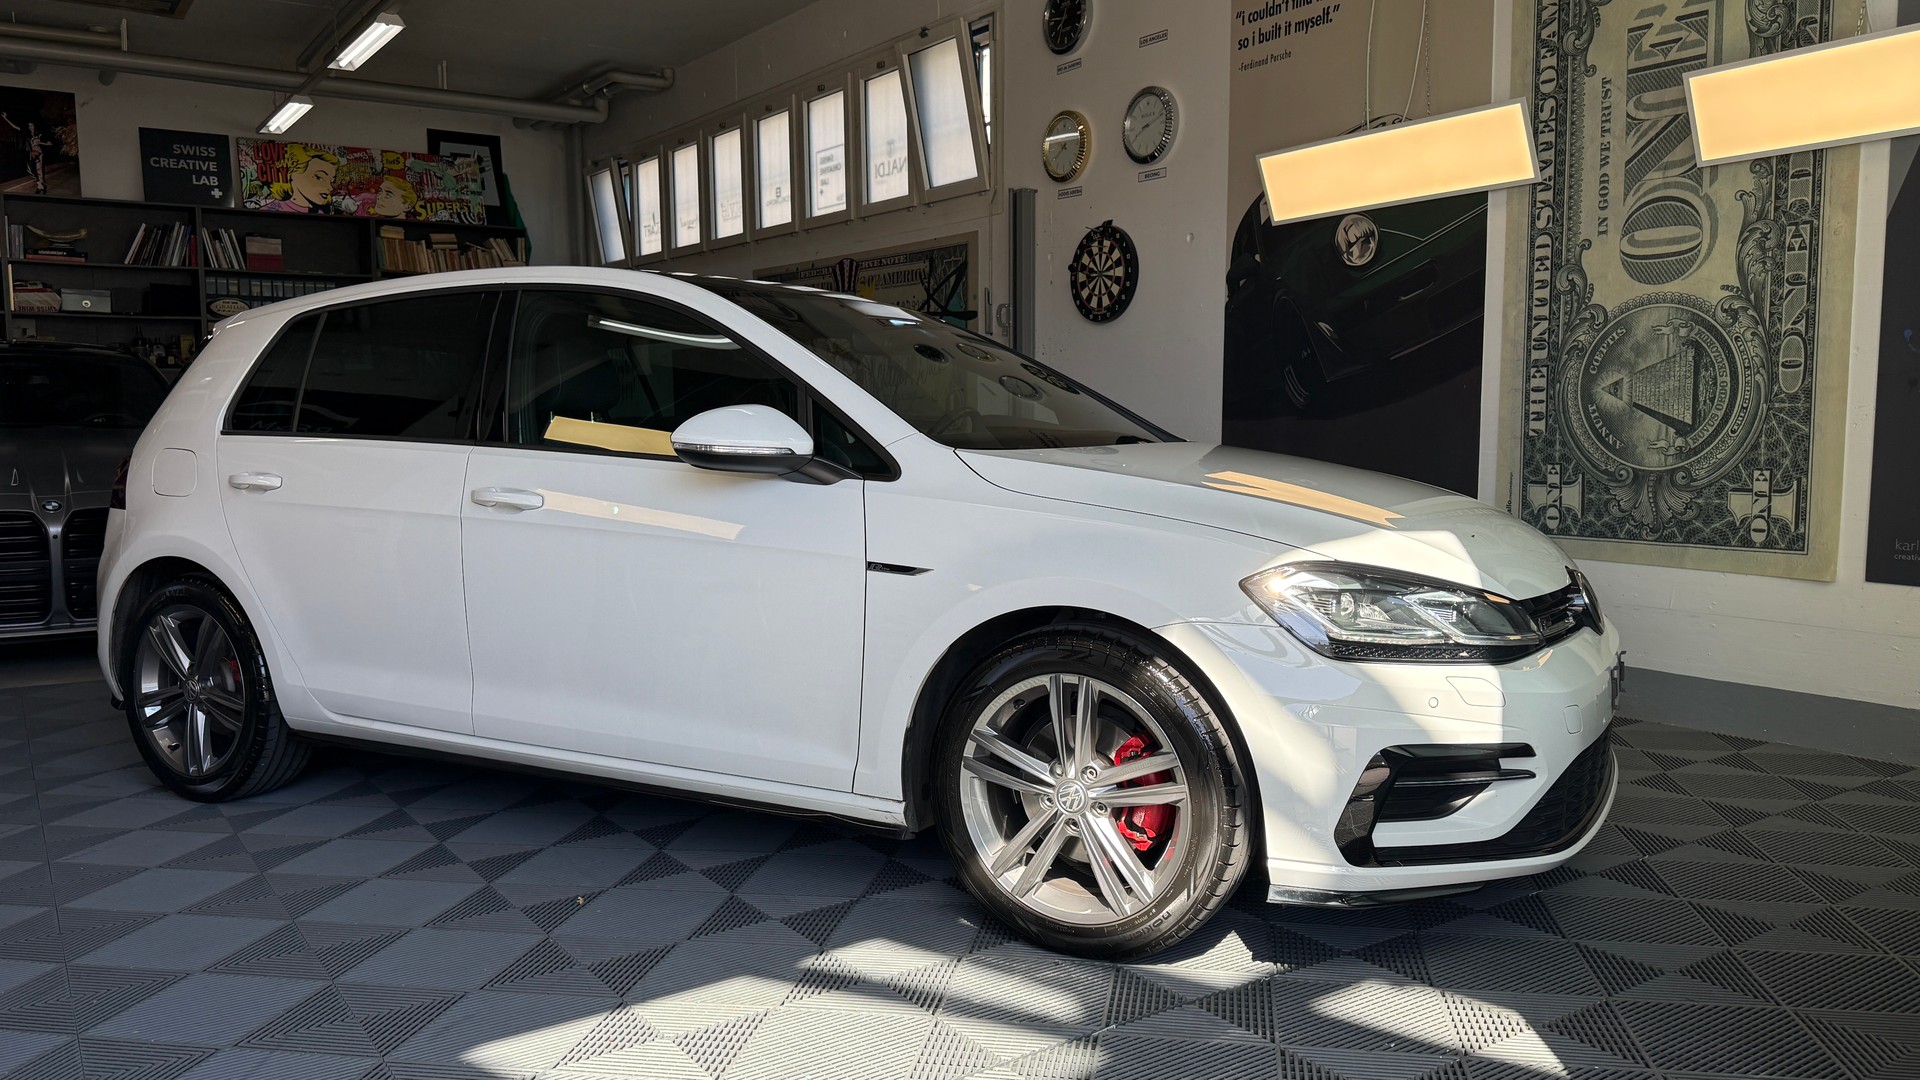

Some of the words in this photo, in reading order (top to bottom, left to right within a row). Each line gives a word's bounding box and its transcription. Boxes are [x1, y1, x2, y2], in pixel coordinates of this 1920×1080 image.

[1237, 37, 1249, 50] so
[1258, 23, 1281, 44] built
[1284, 21, 1292, 36] it
[1270, 49, 1292, 64] Porsche
[1538, 47, 1558, 94] OF
[1600, 77, 1612, 138] TRUST
[149, 157, 218, 172] CREATIVE
[172, 144, 217, 157] SWISS
[253, 142, 287, 162] LOVE
[1534, 95, 1556, 230] STATES
[1599, 141, 1611, 171] WE
[192, 174, 219, 186] LAB
[257, 163, 288, 183] CITY
[1598, 173, 1609, 211] GOD
[1597, 216, 1608, 237] IN
[881, 254, 907, 266] NOTE
[1531, 233, 1553, 364] UNITED
[1779, 220, 1811, 393] ONE
[1529, 366, 1548, 436] THE
[1690, 412, 1719, 447] NOVUS
[1718, 380, 1729, 412] ORDO
[1732, 409, 1746, 431] THE
[1739, 367, 1751, 408] GREAT
[1588, 403, 1624, 450] ANNUIT
[1546, 464, 1562, 529] ONE
[1750, 470, 1770, 543] ONE
